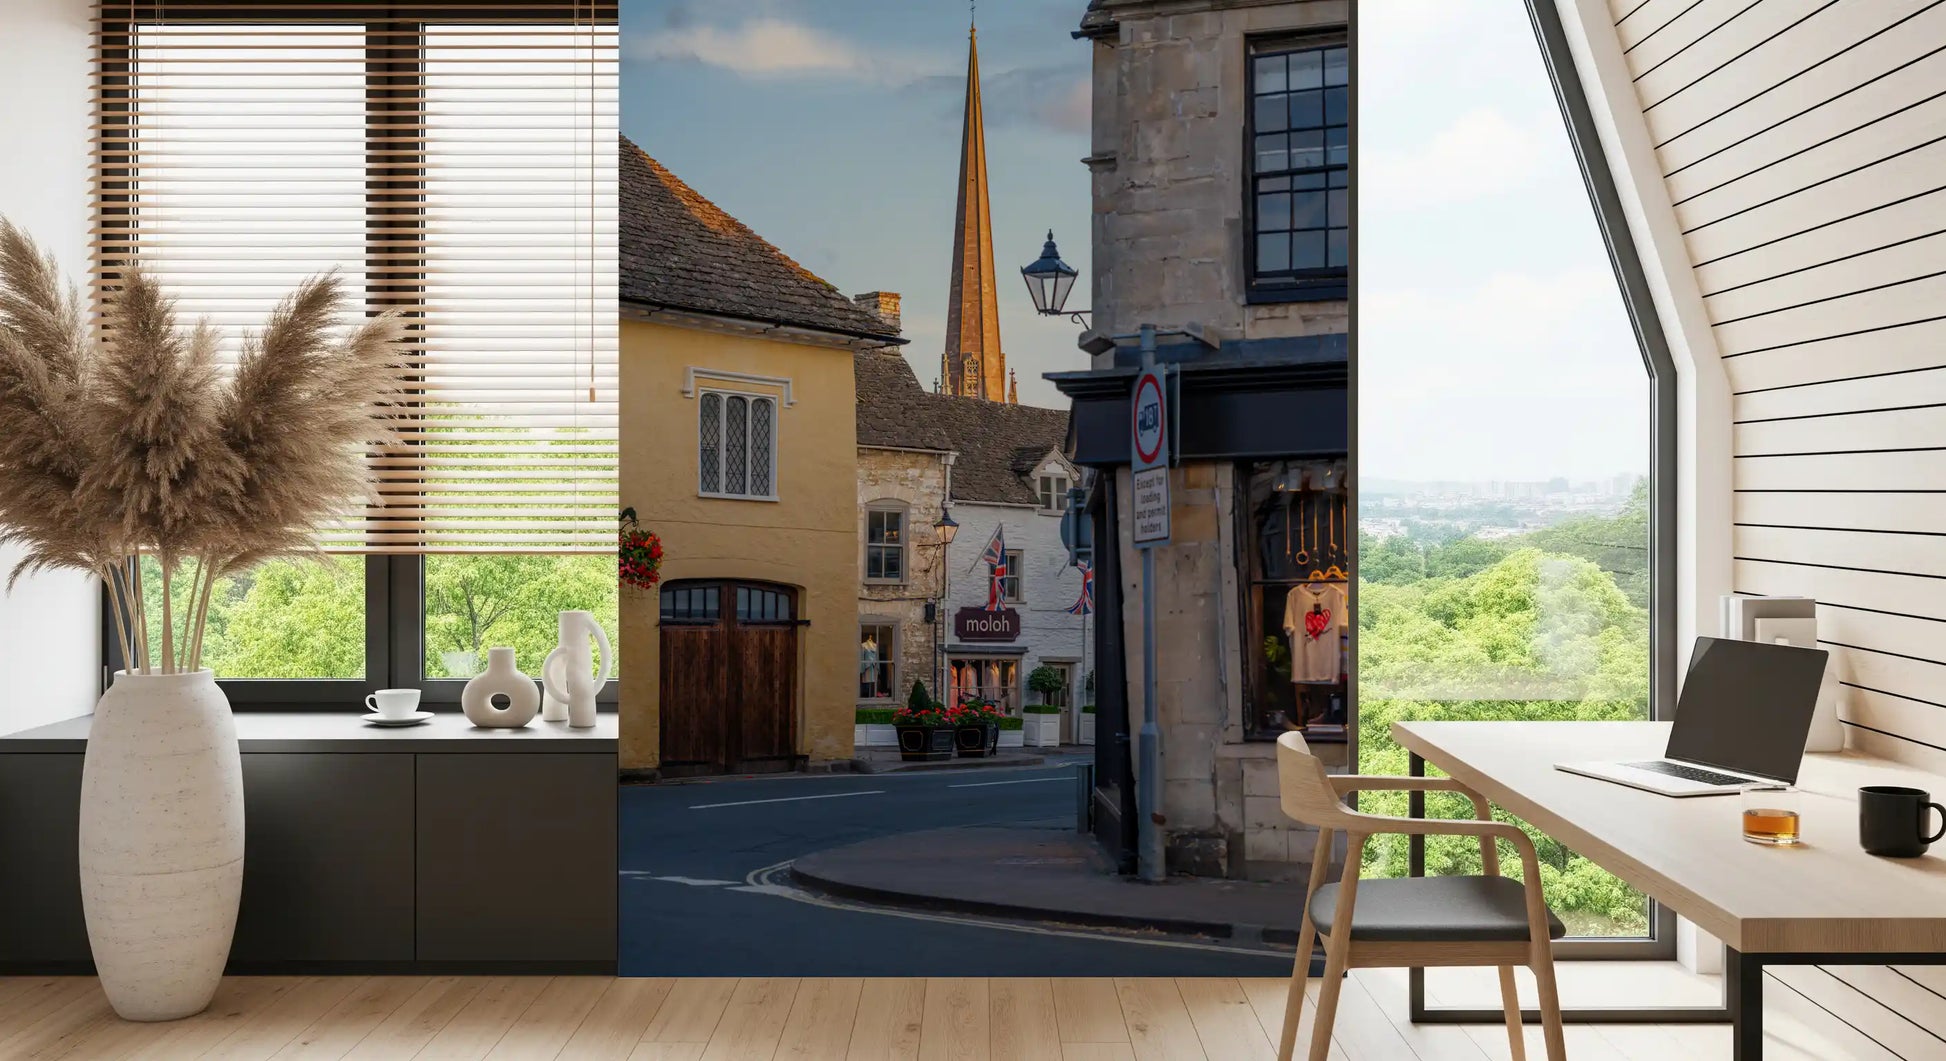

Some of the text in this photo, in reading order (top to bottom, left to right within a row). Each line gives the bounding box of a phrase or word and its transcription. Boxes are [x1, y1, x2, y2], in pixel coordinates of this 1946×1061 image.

[1136, 475, 1164, 490] Except for
[1140, 491, 1161, 504] loading
[1136, 504, 1166, 520] and permit
[1140, 521, 1161, 534] holders
[966, 614, 1010, 632] moloh
